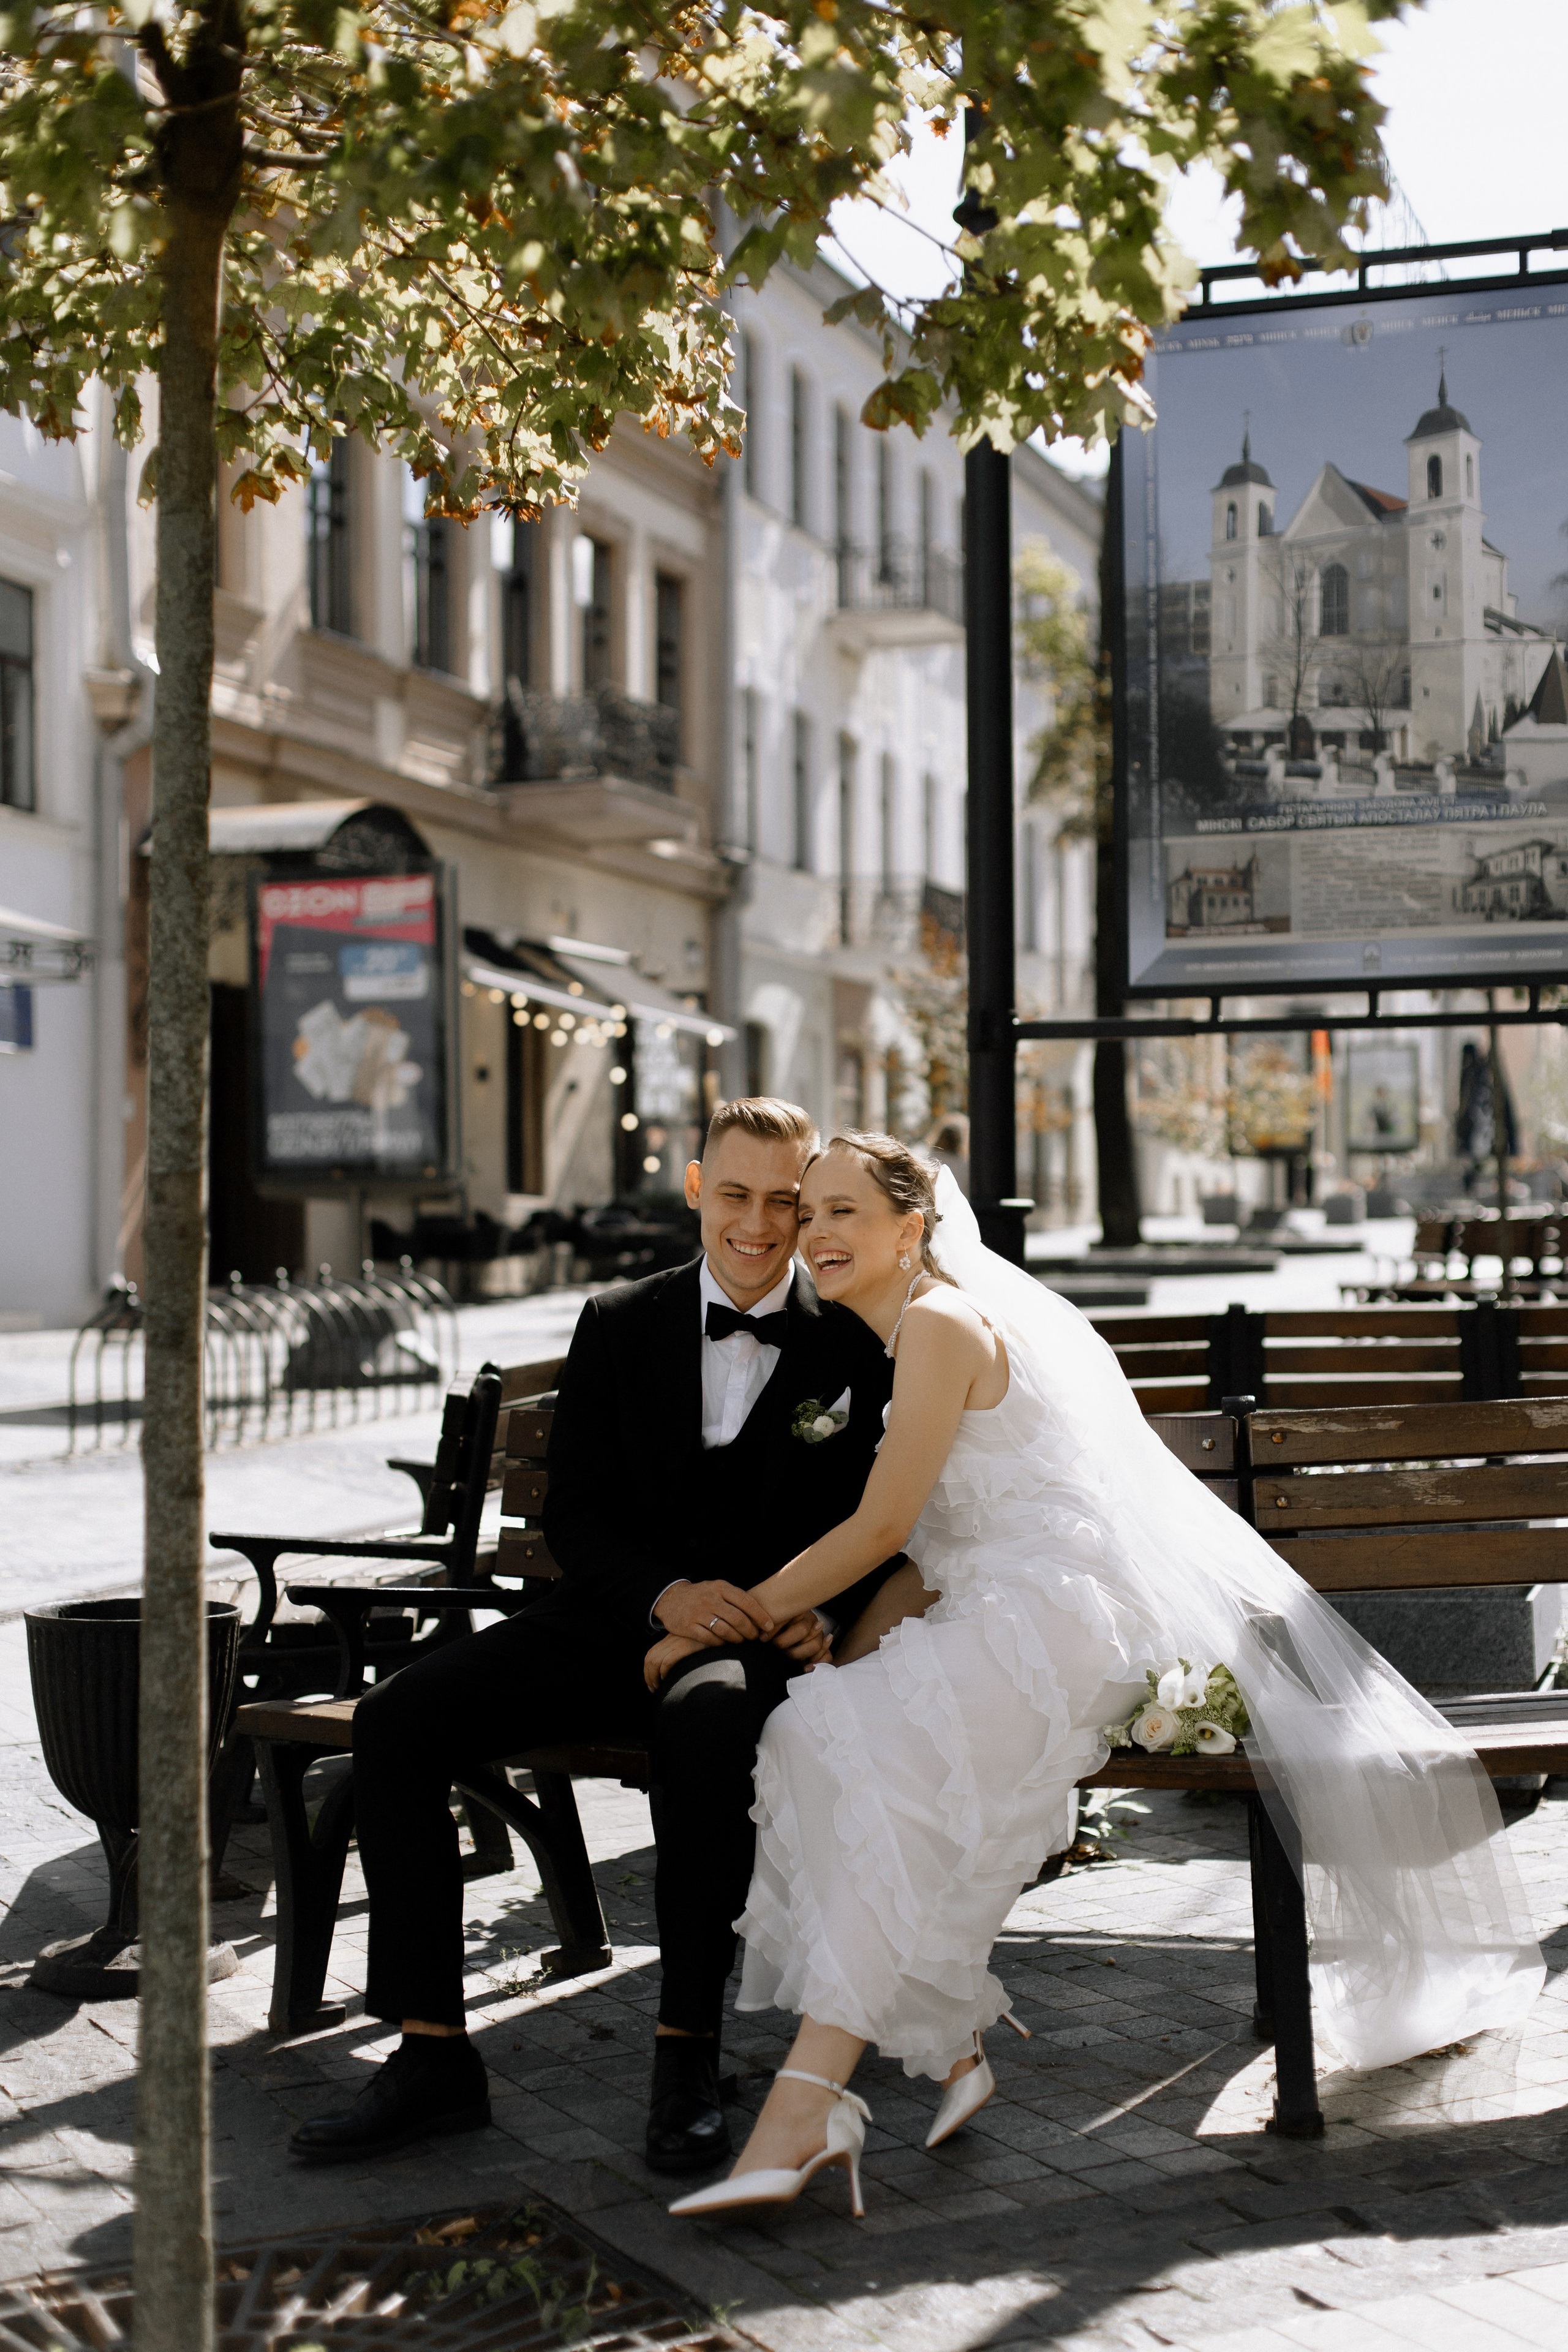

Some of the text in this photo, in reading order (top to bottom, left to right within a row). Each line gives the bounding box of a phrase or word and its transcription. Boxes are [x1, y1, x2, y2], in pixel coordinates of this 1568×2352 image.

[1246, 815, 1295, 831] САБОР
[1296, 812, 1355, 829] СВЯТЫХ
[1442, 804, 1490, 822] ПЯТРА
